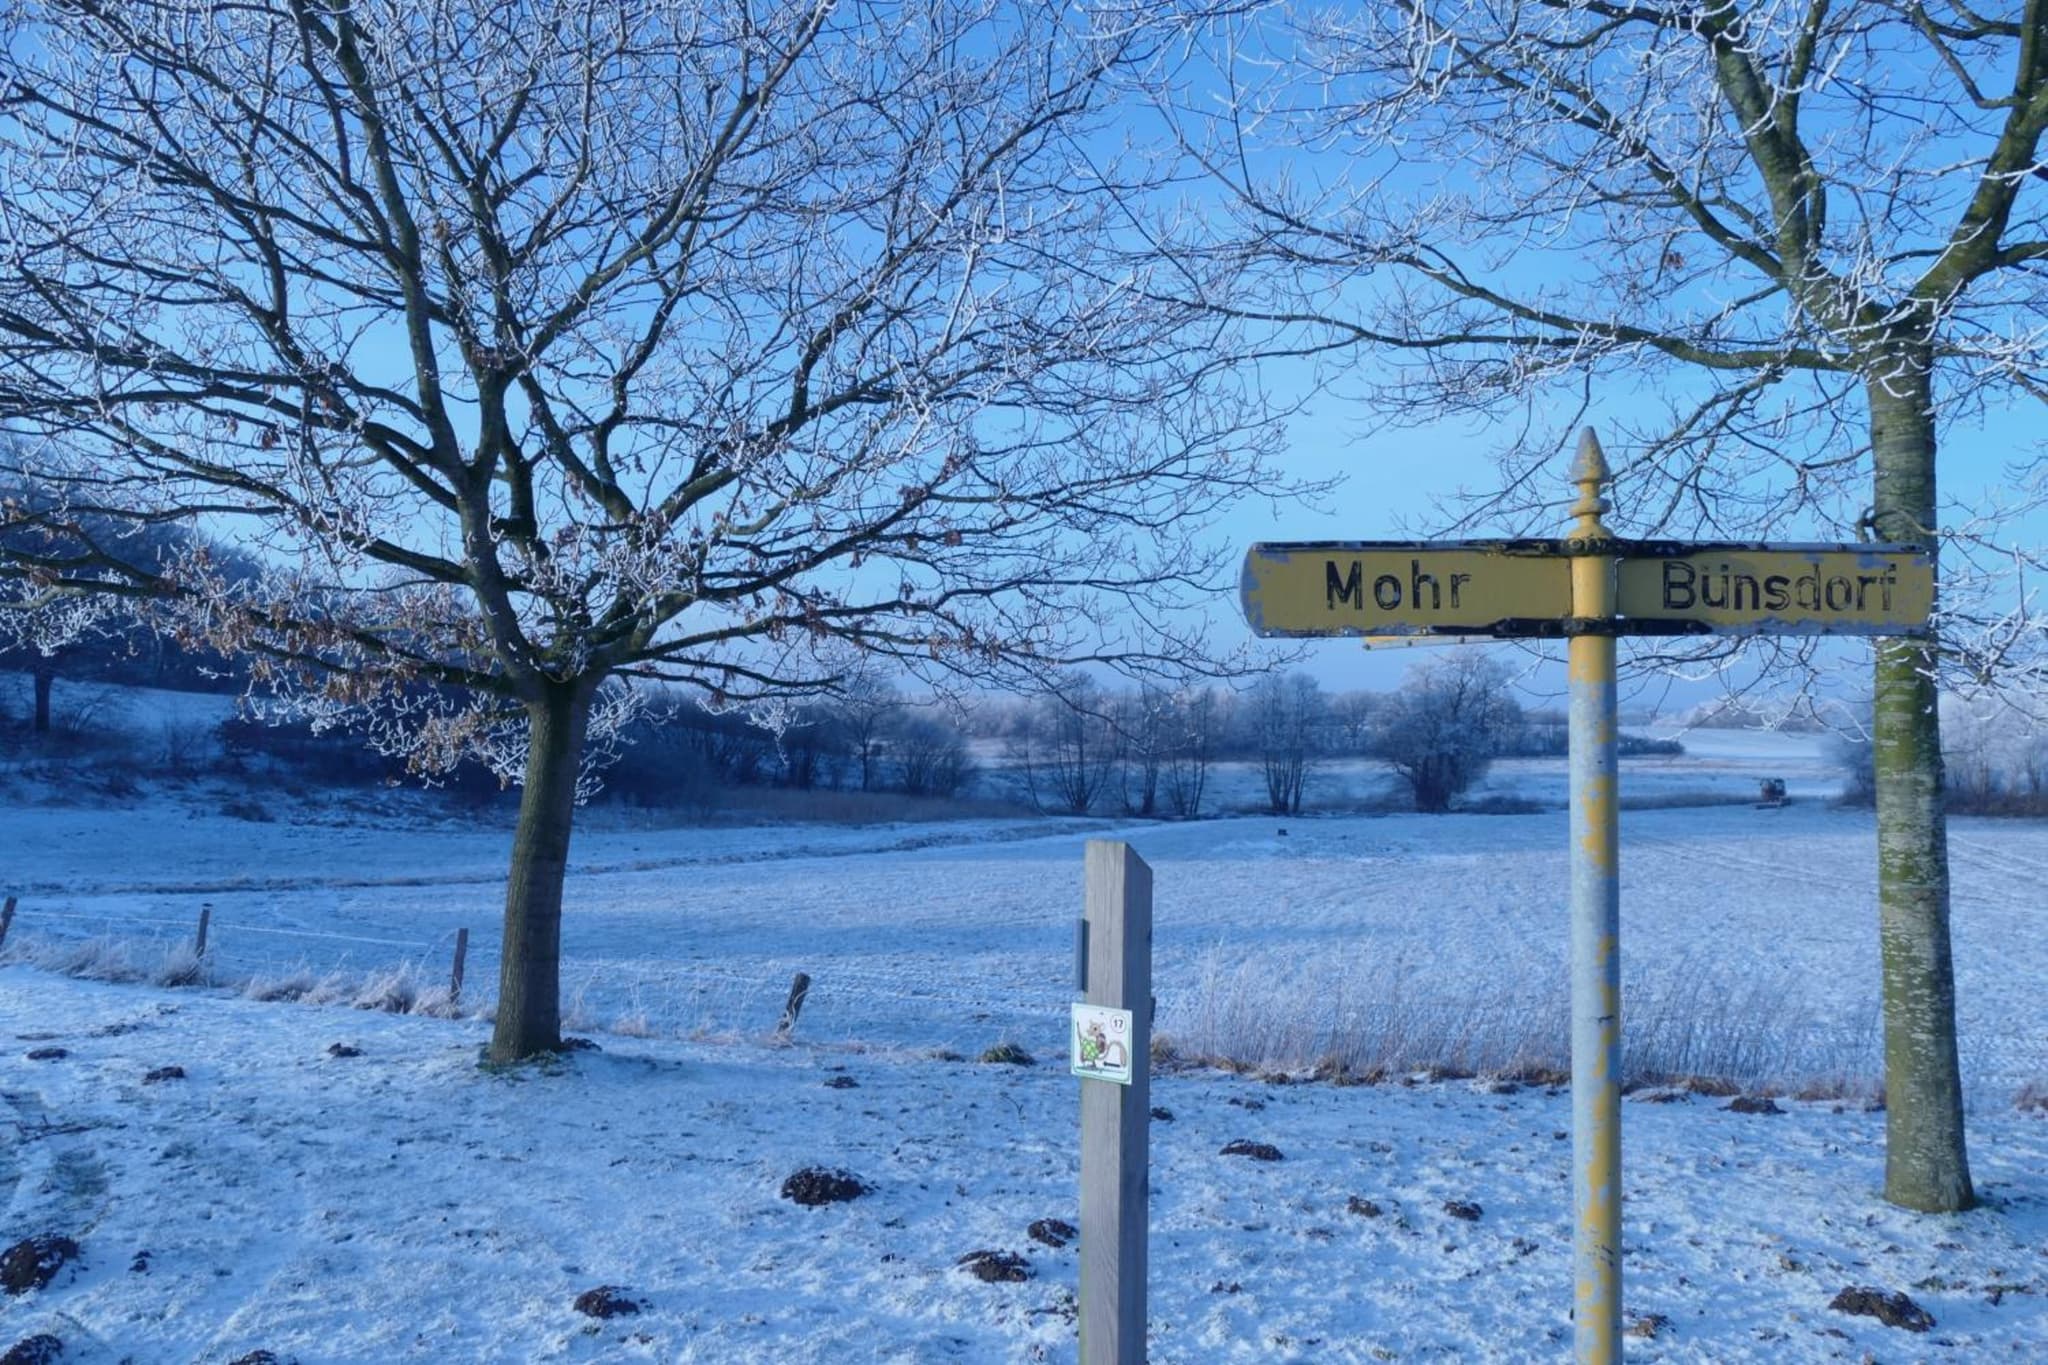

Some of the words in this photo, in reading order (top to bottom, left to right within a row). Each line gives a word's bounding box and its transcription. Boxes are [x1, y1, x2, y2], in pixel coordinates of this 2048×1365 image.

[1325, 559, 1472, 611] Mohr
[1662, 560, 1897, 612] Bünsdorf
[1113, 1018, 1124, 1029] 17
